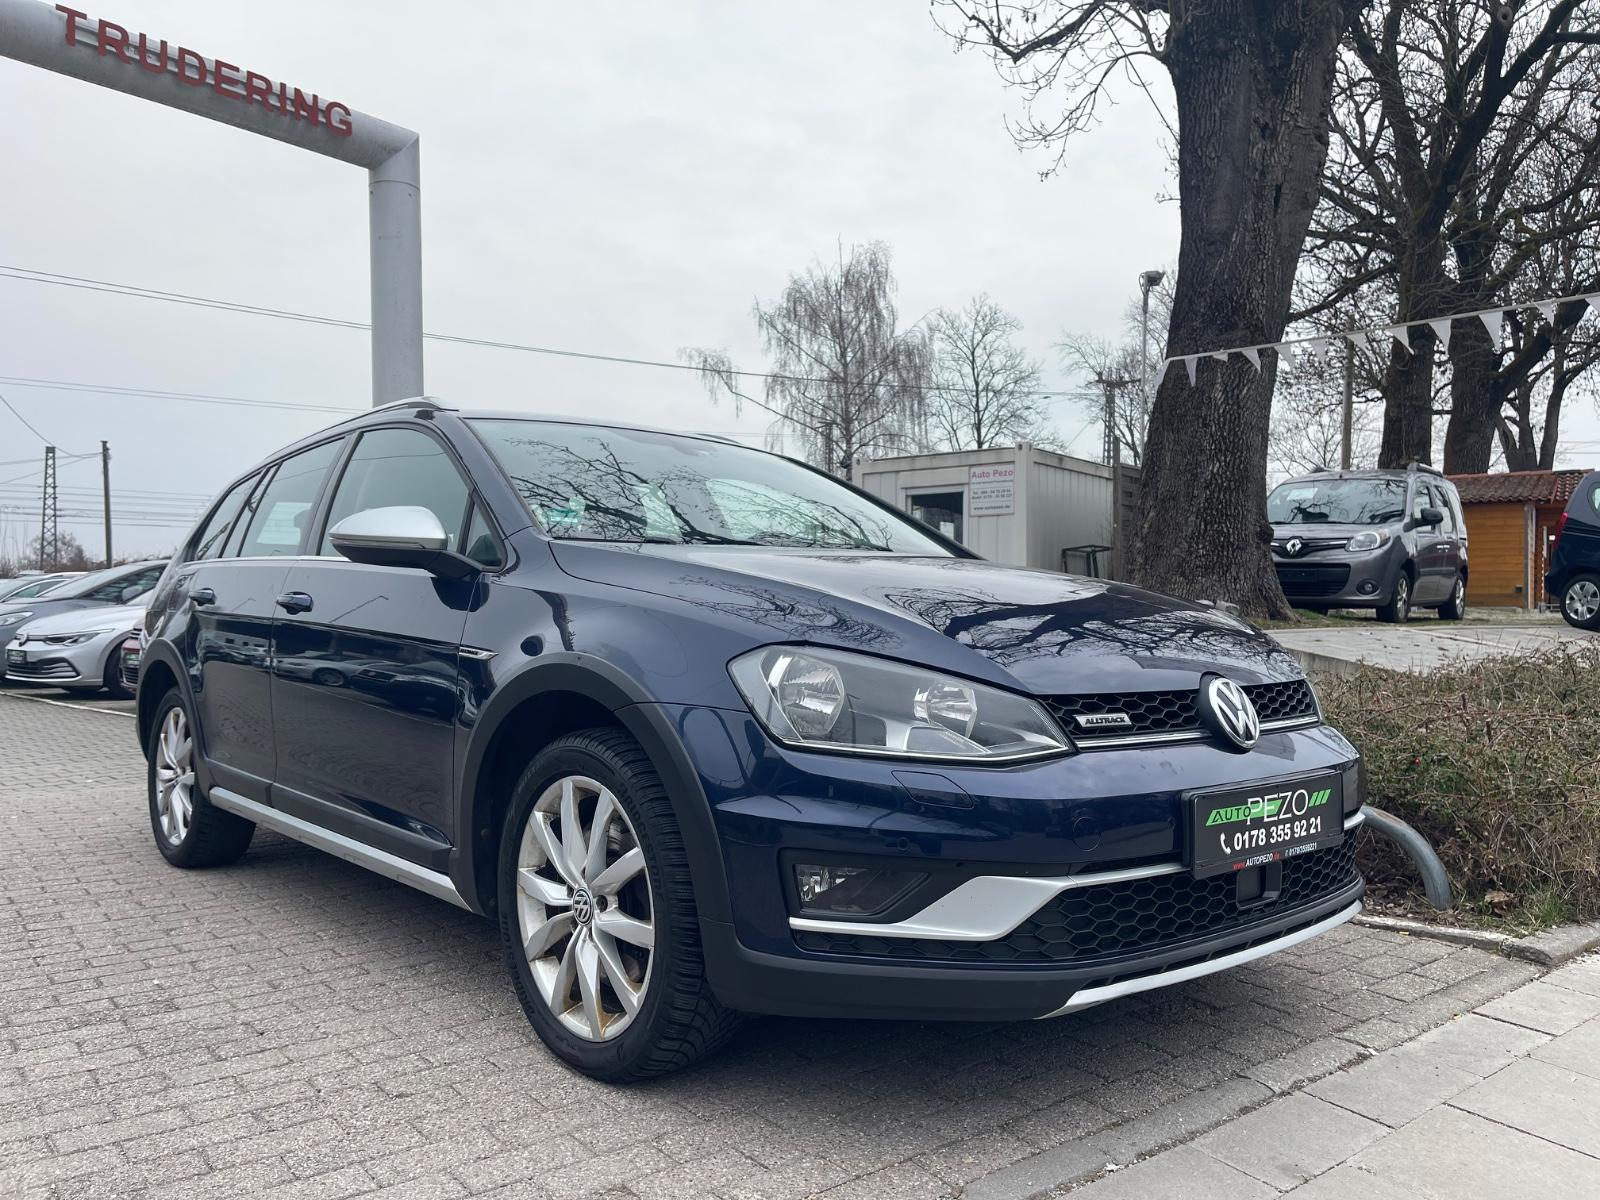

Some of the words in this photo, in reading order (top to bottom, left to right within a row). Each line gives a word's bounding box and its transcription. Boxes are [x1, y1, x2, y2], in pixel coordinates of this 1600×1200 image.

[55, 3, 353, 137] TRUDERING
[971, 471, 990, 479] Auto
[992, 469, 1014, 478] Pezo
[1085, 716, 1126, 725] ALLTRACK
[1212, 806, 1251, 823] AUTO
[1246, 789, 1309, 825] PEZO
[1233, 828, 1266, 850] 0178
[1269, 823, 1291, 844] 355
[1293, 819, 1307, 838] 92
[1309, 815, 1321, 834] 21
